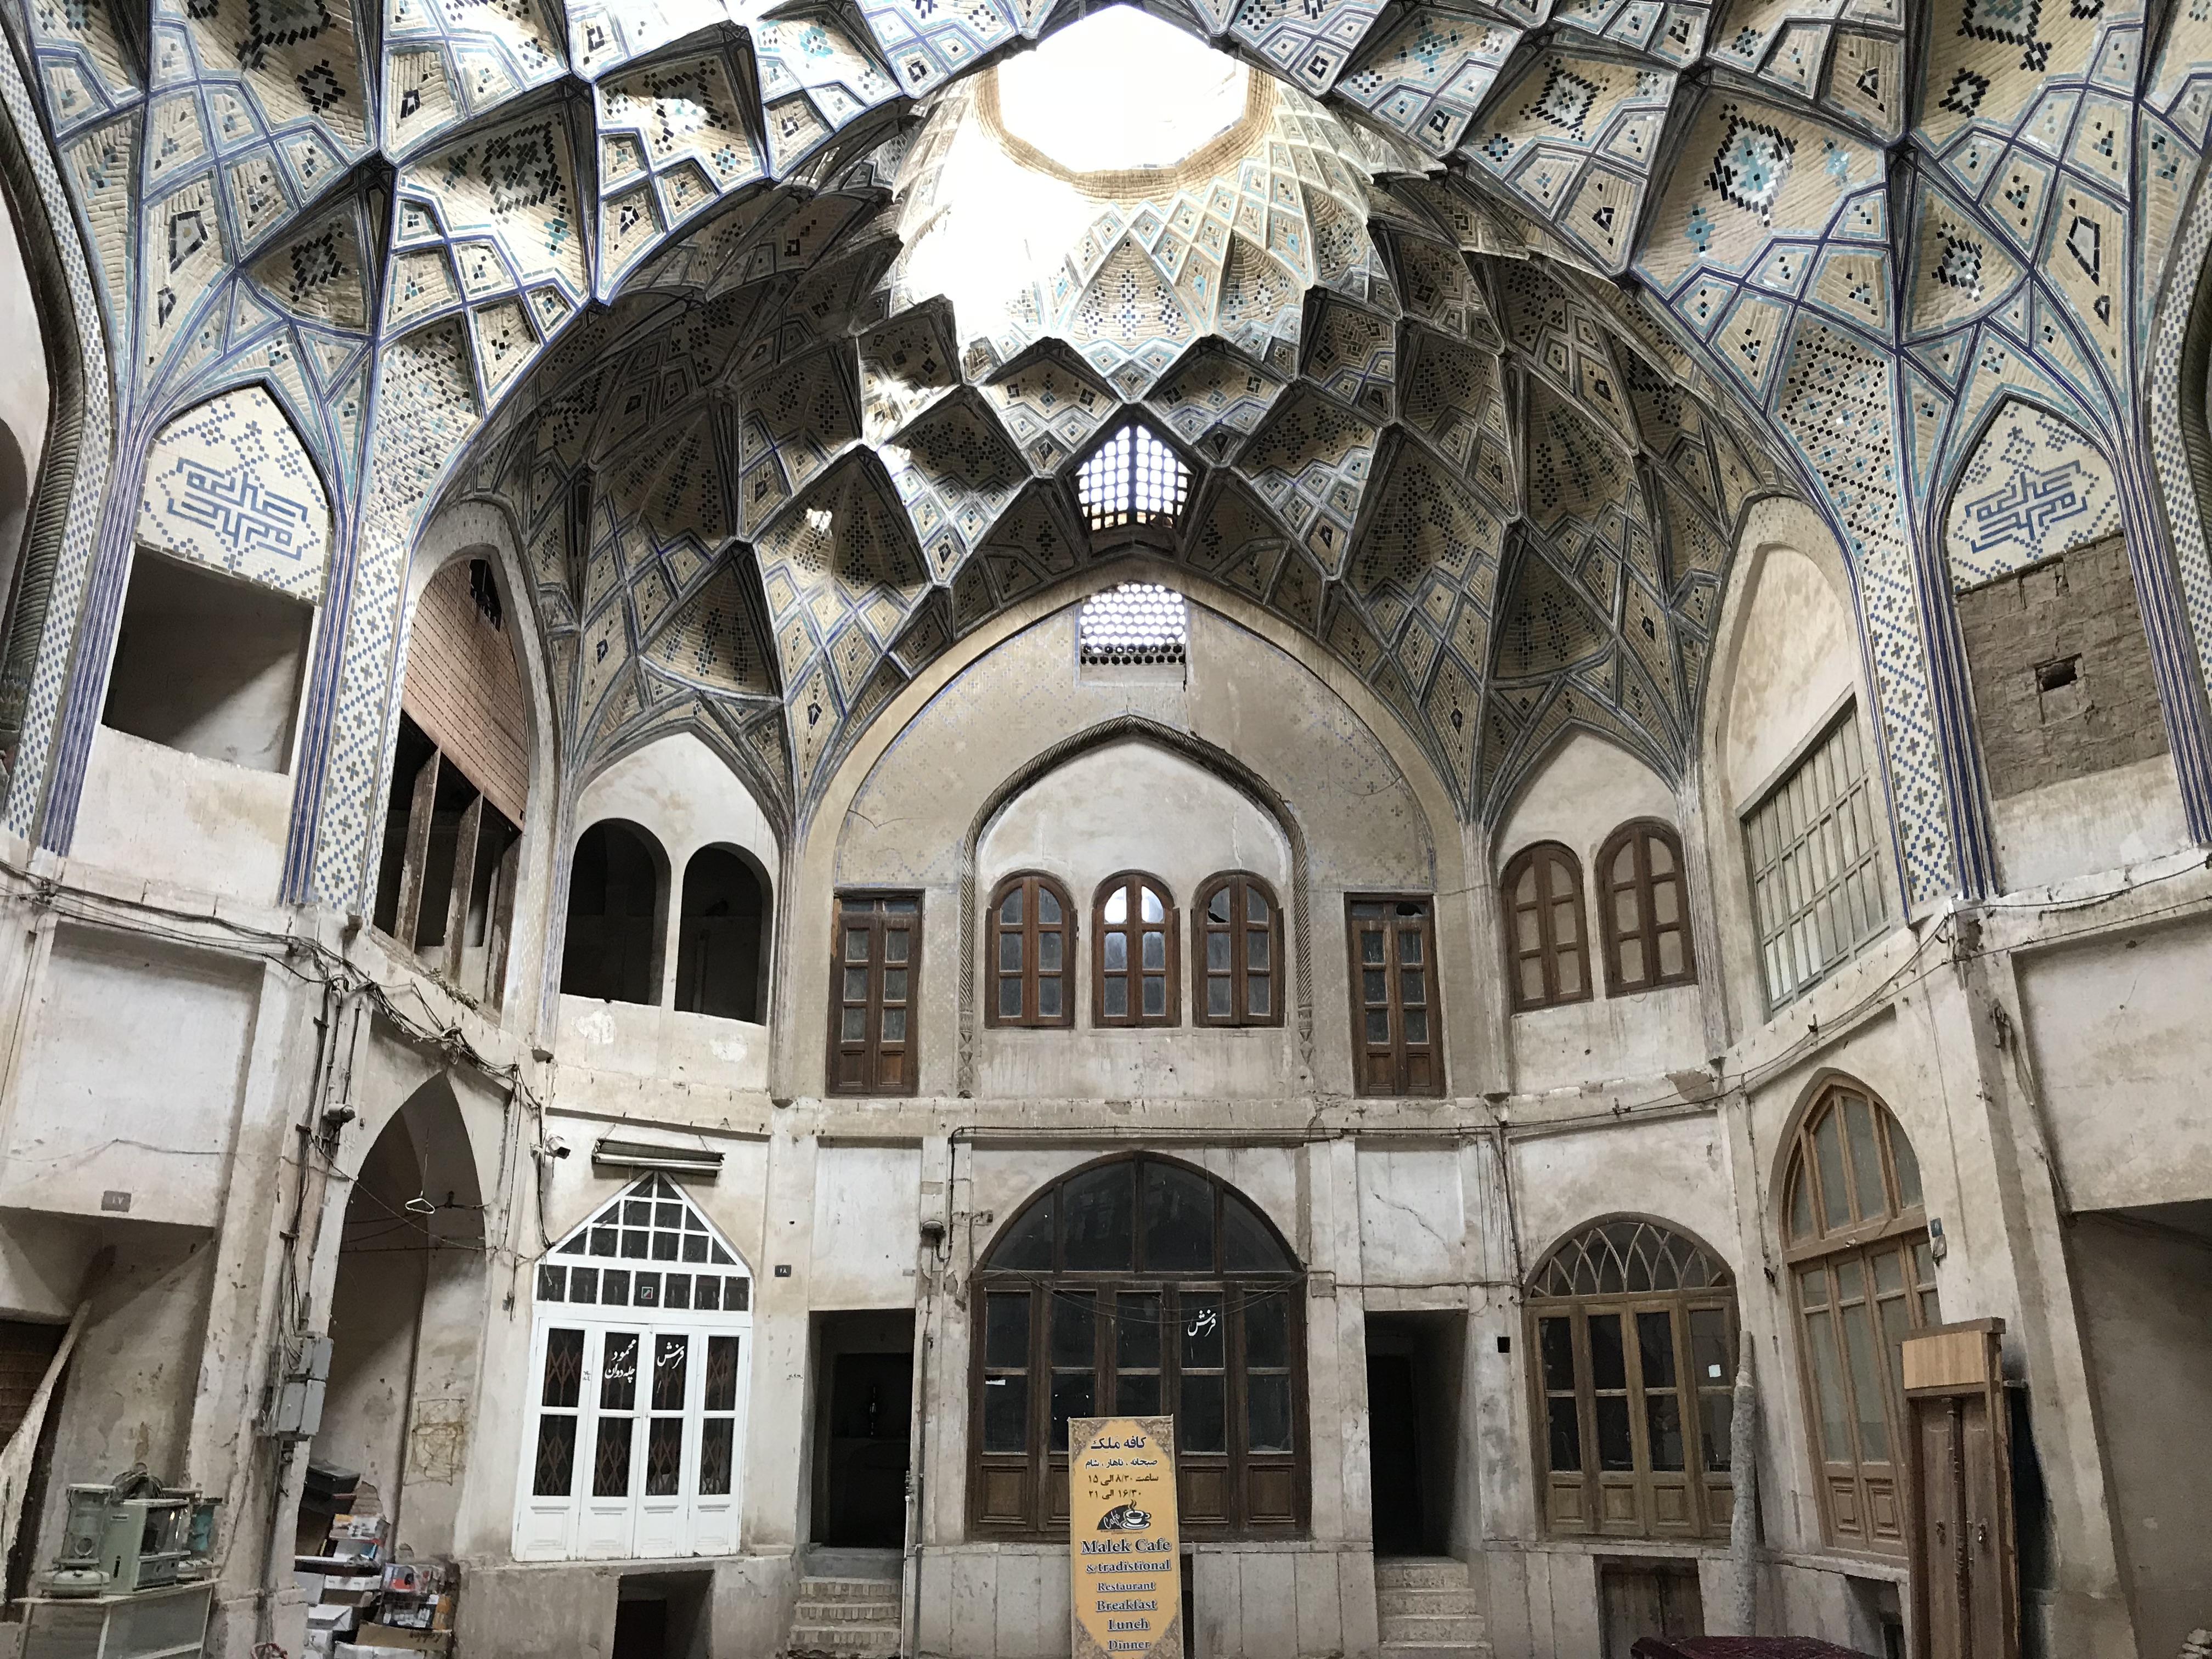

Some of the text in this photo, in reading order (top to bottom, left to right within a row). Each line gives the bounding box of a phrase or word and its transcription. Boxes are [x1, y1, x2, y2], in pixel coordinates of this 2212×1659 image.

[1188, 1309, 1216, 1337] فرش
[611, 1339, 636, 1361] محمود
[657, 1342, 685, 1369] فرش
[1123, 1436, 1147, 1448] کافه
[1086, 1459, 1099, 1469] شام
[1088, 1474, 1098, 1483] ۱۵
[1101, 1474, 1114, 1486] الی
[1135, 1473, 1159, 1482] ساعت
[1102, 1489, 1114, 1499] الی
[1081, 1537, 1171, 1554] Malek Cafe
[1086, 1559, 1171, 1572] & tradistional
[1098, 1582, 1155, 1592] Restaurant
[1096, 1599, 1156, 1611] Breakfast
[1108, 1617, 1149, 1630] Lunch
[1108, 1639, 1150, 1650] Dinner
